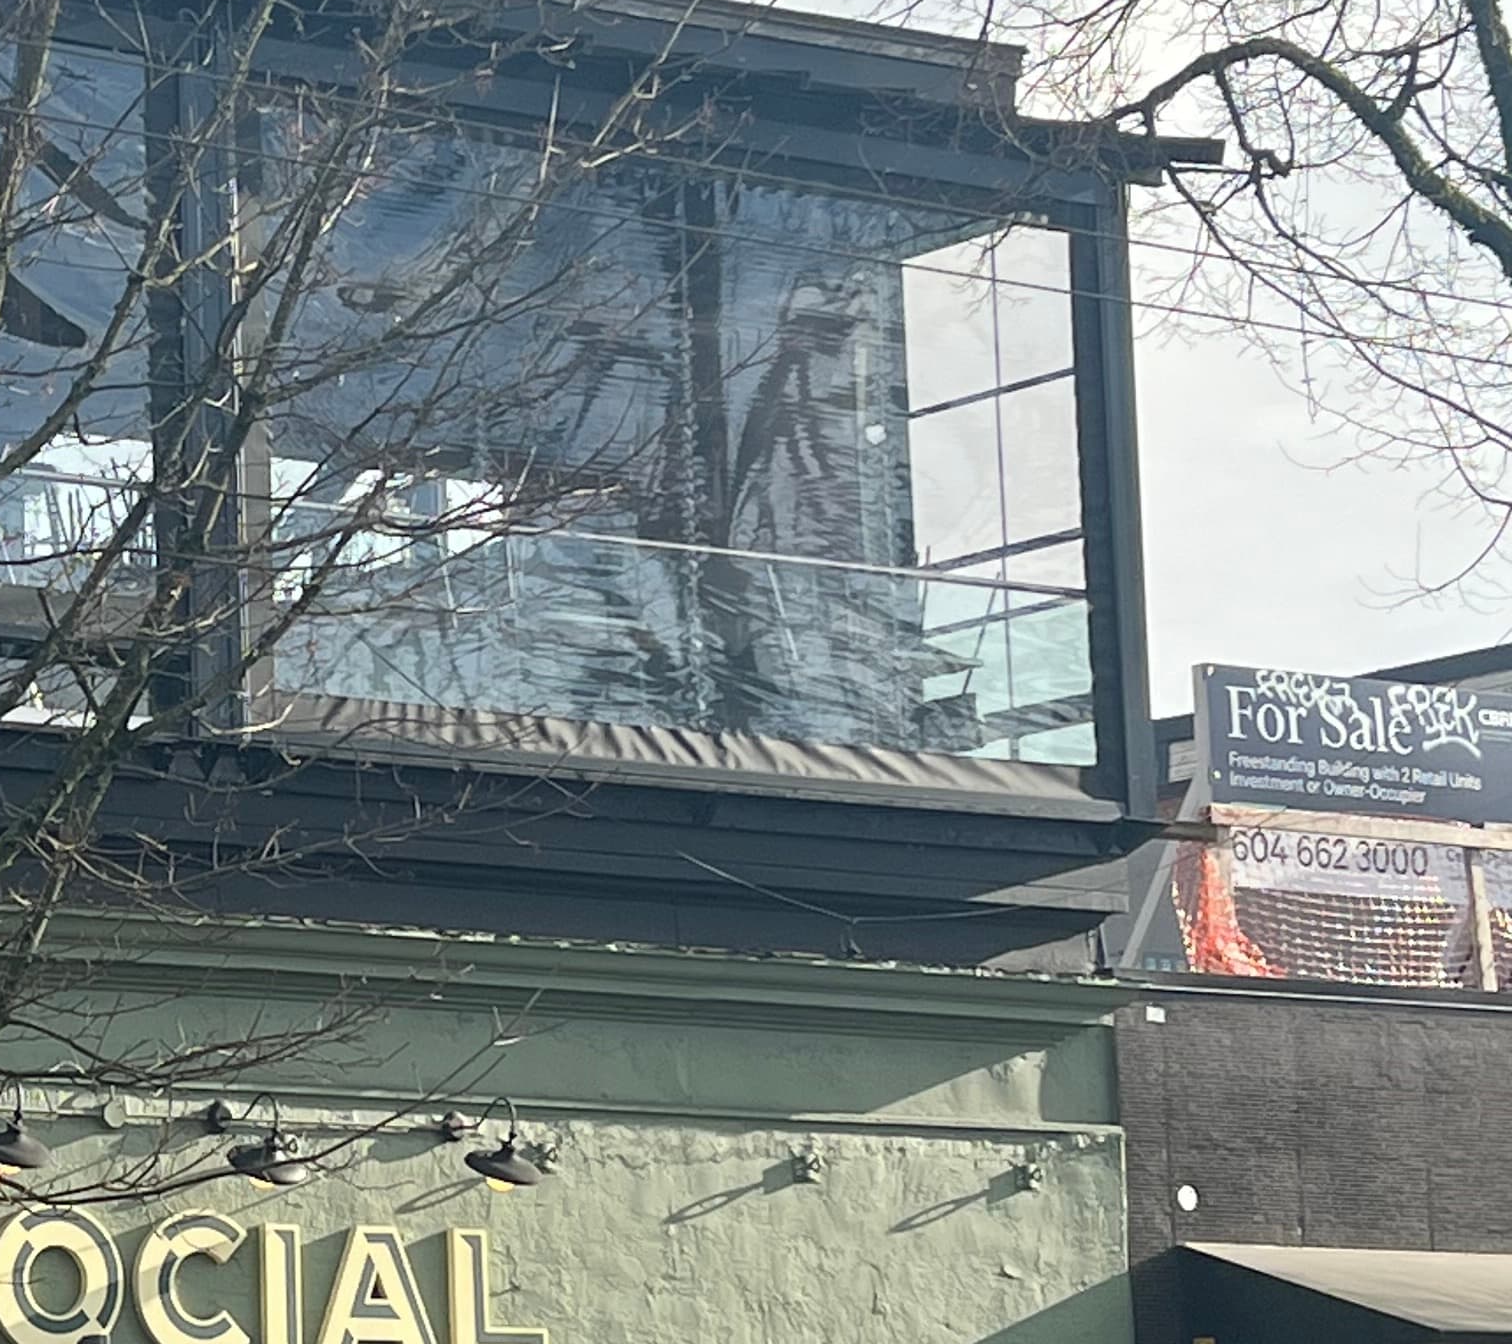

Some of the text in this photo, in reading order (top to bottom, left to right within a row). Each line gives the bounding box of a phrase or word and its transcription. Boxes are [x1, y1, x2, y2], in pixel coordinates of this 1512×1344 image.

[1225, 685, 1414, 756] For Sale
[1478, 709, 1512, 728] CBR
[1228, 751, 1483, 791] Freestanding Building with 2 Retail Units
[1229, 770, 1427, 806] Investment or Owner-Occupier
[1233, 829, 1288, 866] 604
[1297, 835, 1348, 870] 662
[1356, 840, 1429, 877] 3000
